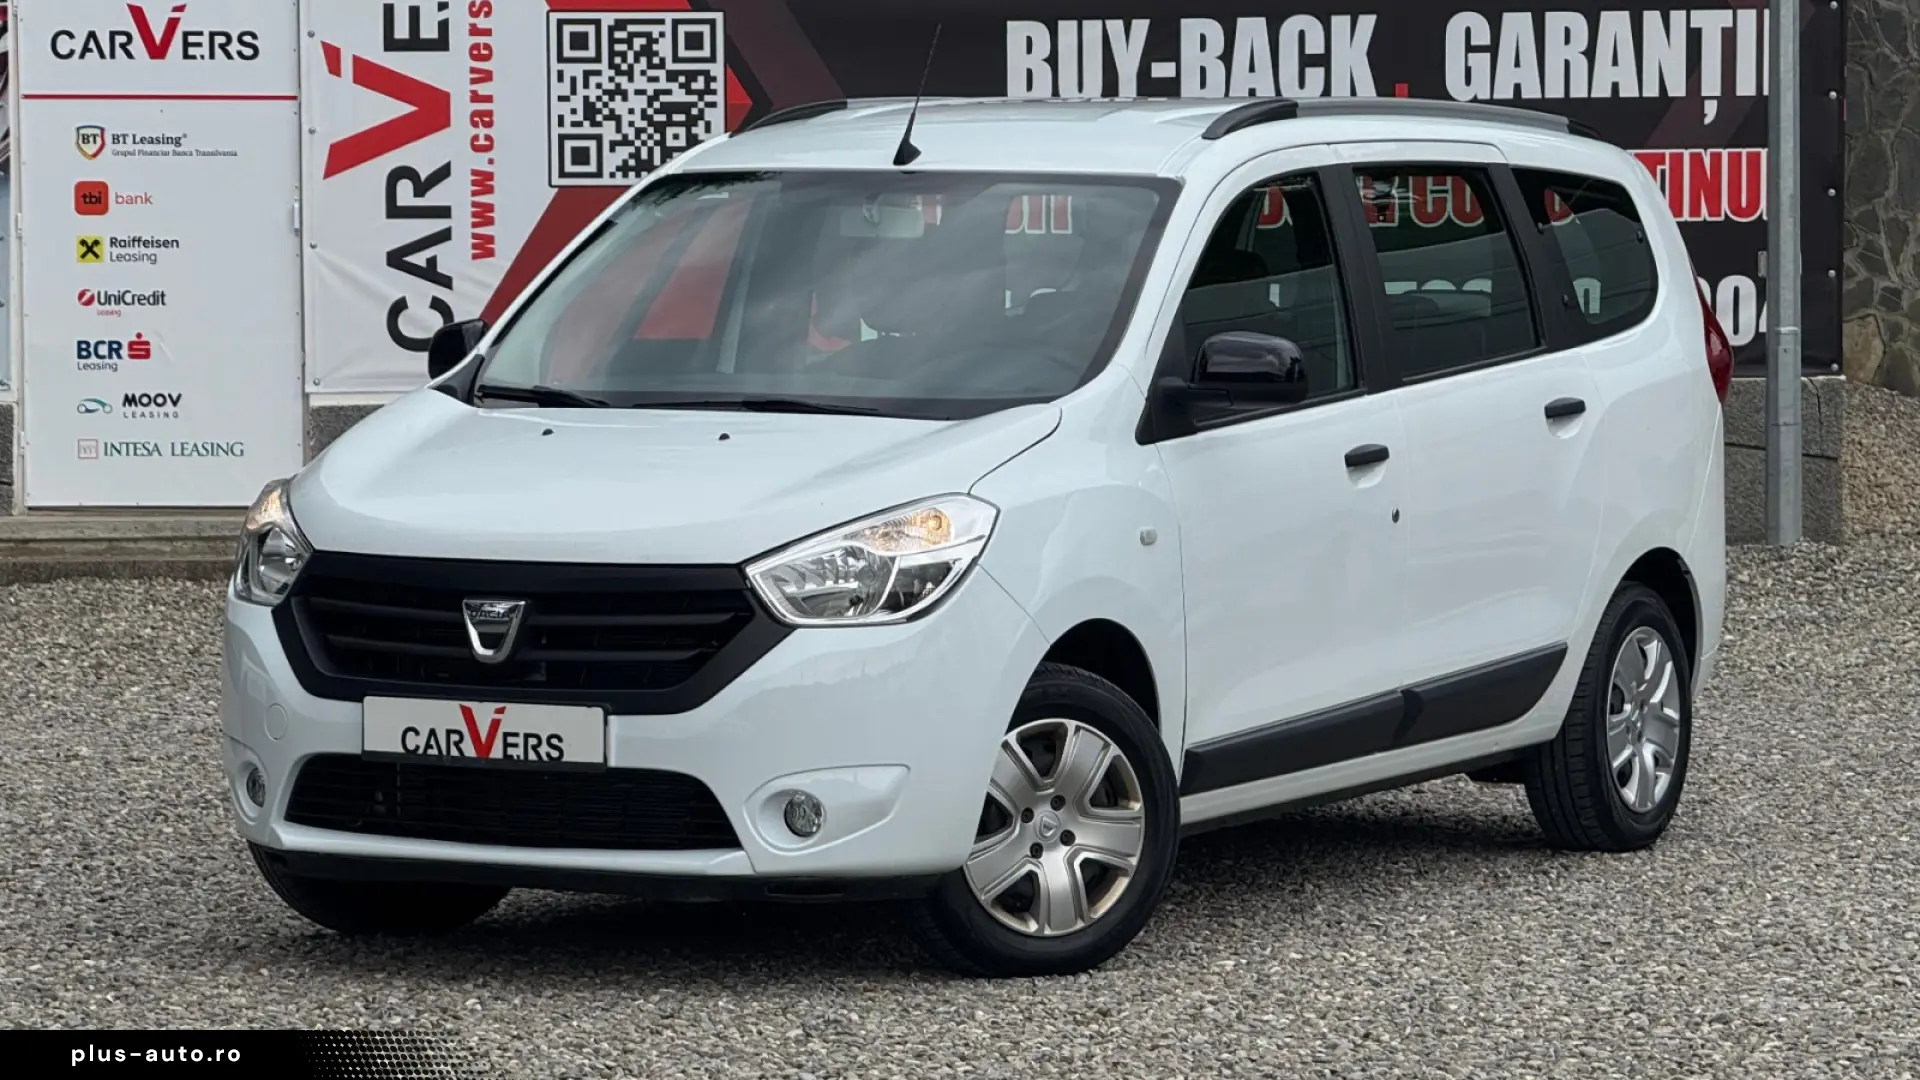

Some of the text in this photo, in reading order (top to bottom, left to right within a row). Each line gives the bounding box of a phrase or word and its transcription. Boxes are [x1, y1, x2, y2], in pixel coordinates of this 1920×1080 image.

[51, 3, 260, 61] CARVERS
[1006, 14, 1378, 98] BUY-BACK
[80, 133, 99, 145] BT
[111, 133, 129, 145] BT
[171, 149, 194, 157] Banca
[81, 191, 153, 205] tbi bank
[109, 235, 180, 249] Raiffeisen
[109, 251, 158, 265] Leasing
[96, 289, 167, 307] UniCredit
[76, 340, 124, 360] BCR
[77, 361, 119, 373] Leasing
[122, 392, 183, 408] MOOV
[123, 411, 179, 419] LEASING
[103, 441, 245, 457] INTESA LEASING
[401, 703, 564, 762] CARVERS
